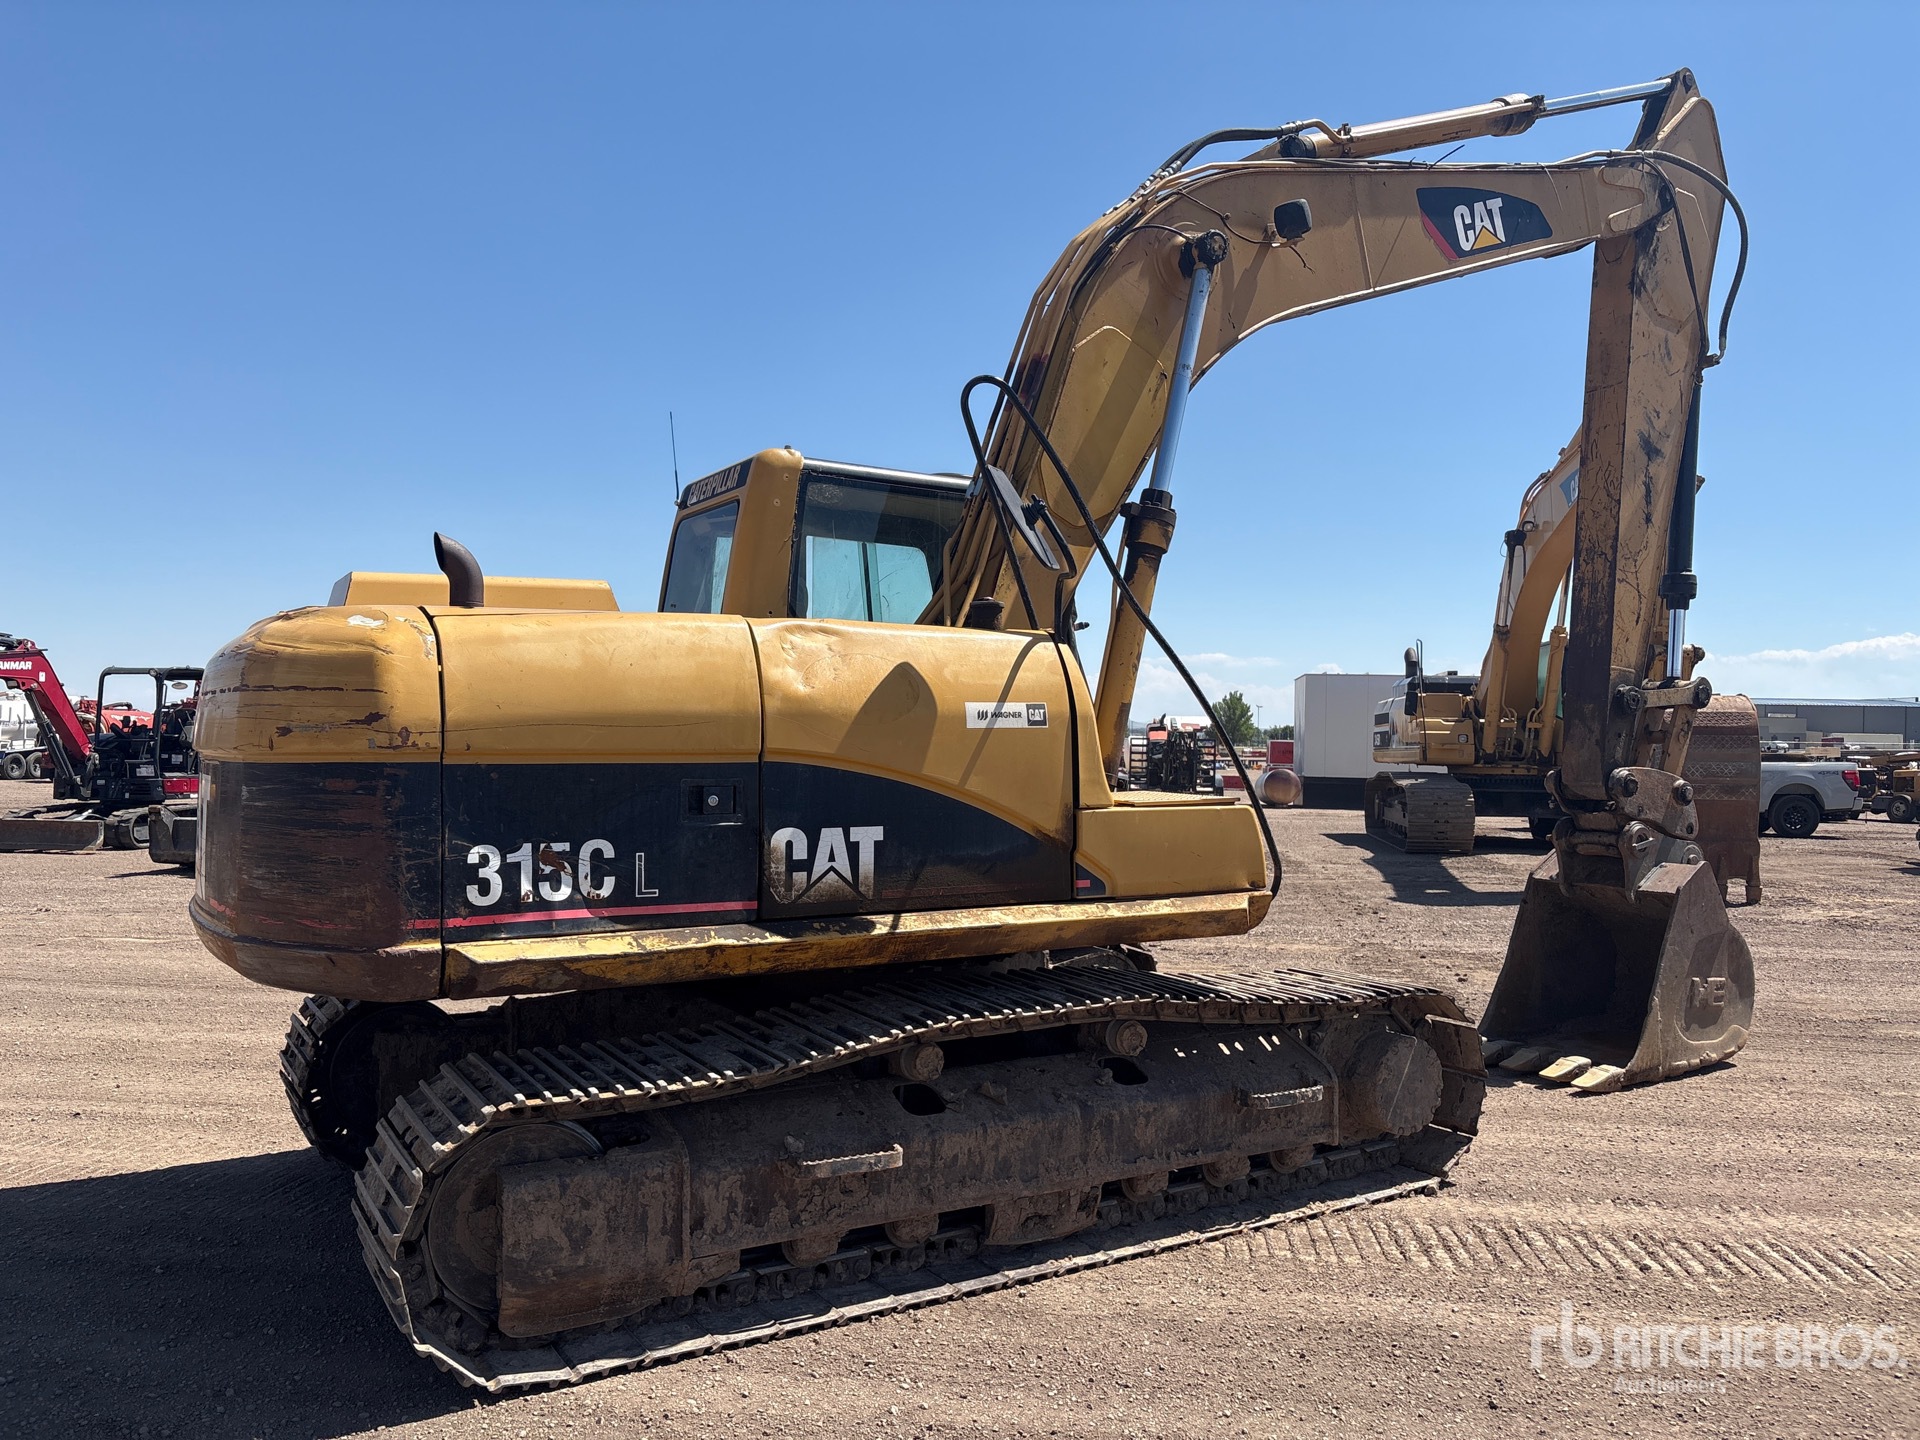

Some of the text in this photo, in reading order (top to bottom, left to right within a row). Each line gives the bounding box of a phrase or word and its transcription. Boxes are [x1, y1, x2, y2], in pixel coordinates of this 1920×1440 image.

[1453, 197, 1506, 251] CAT
[687, 464, 741, 506] CATERPILLAR
[990, 709, 1045, 720] WAGNER CAT
[465, 839, 659, 906] 315C L
[770, 826, 884, 903] CAT
